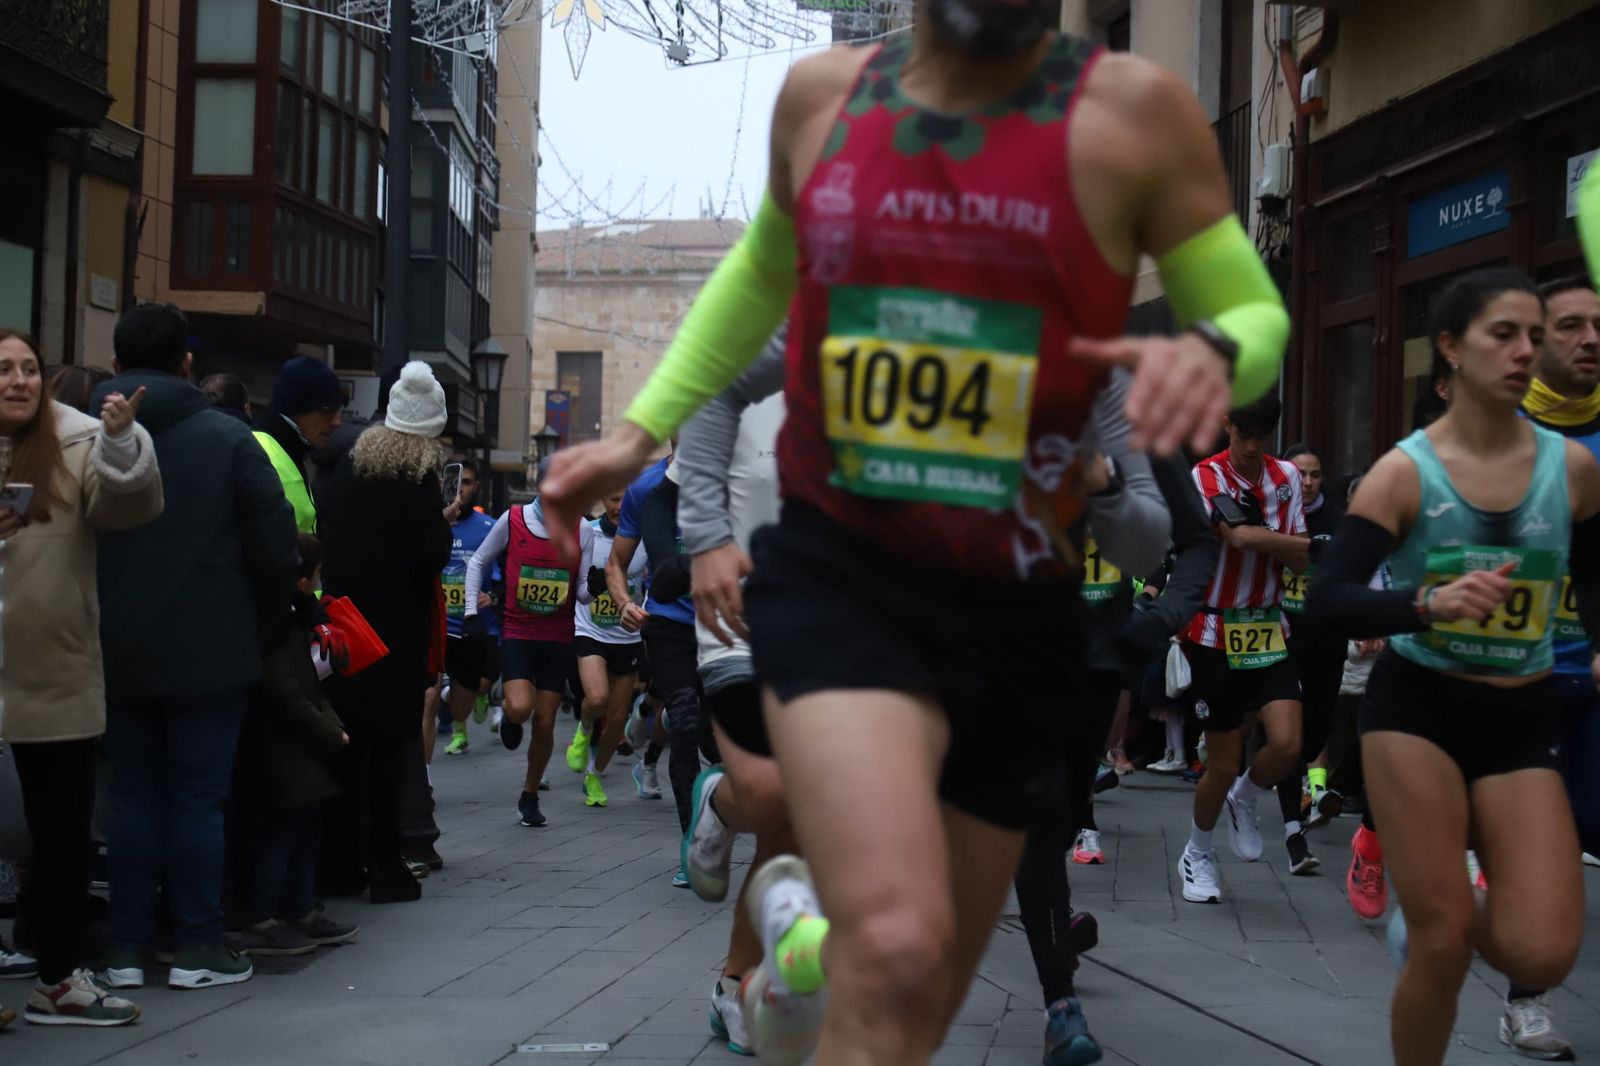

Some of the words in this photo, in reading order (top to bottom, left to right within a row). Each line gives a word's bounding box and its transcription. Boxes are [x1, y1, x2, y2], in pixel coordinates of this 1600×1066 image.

[876, 189, 954, 223] APIS
[958, 192, 1051, 235] DURI
[1439, 193, 1485, 227] NUXE
[833, 345, 991, 436] 1094
[863, 457, 921, 487] CAJA
[925, 463, 1007, 496] RURAL
[521, 583, 560, 604] 1324
[593, 596, 622, 616] 125
[1229, 628, 1274, 653] 627
[1449, 641, 1483, 656] CAJA
